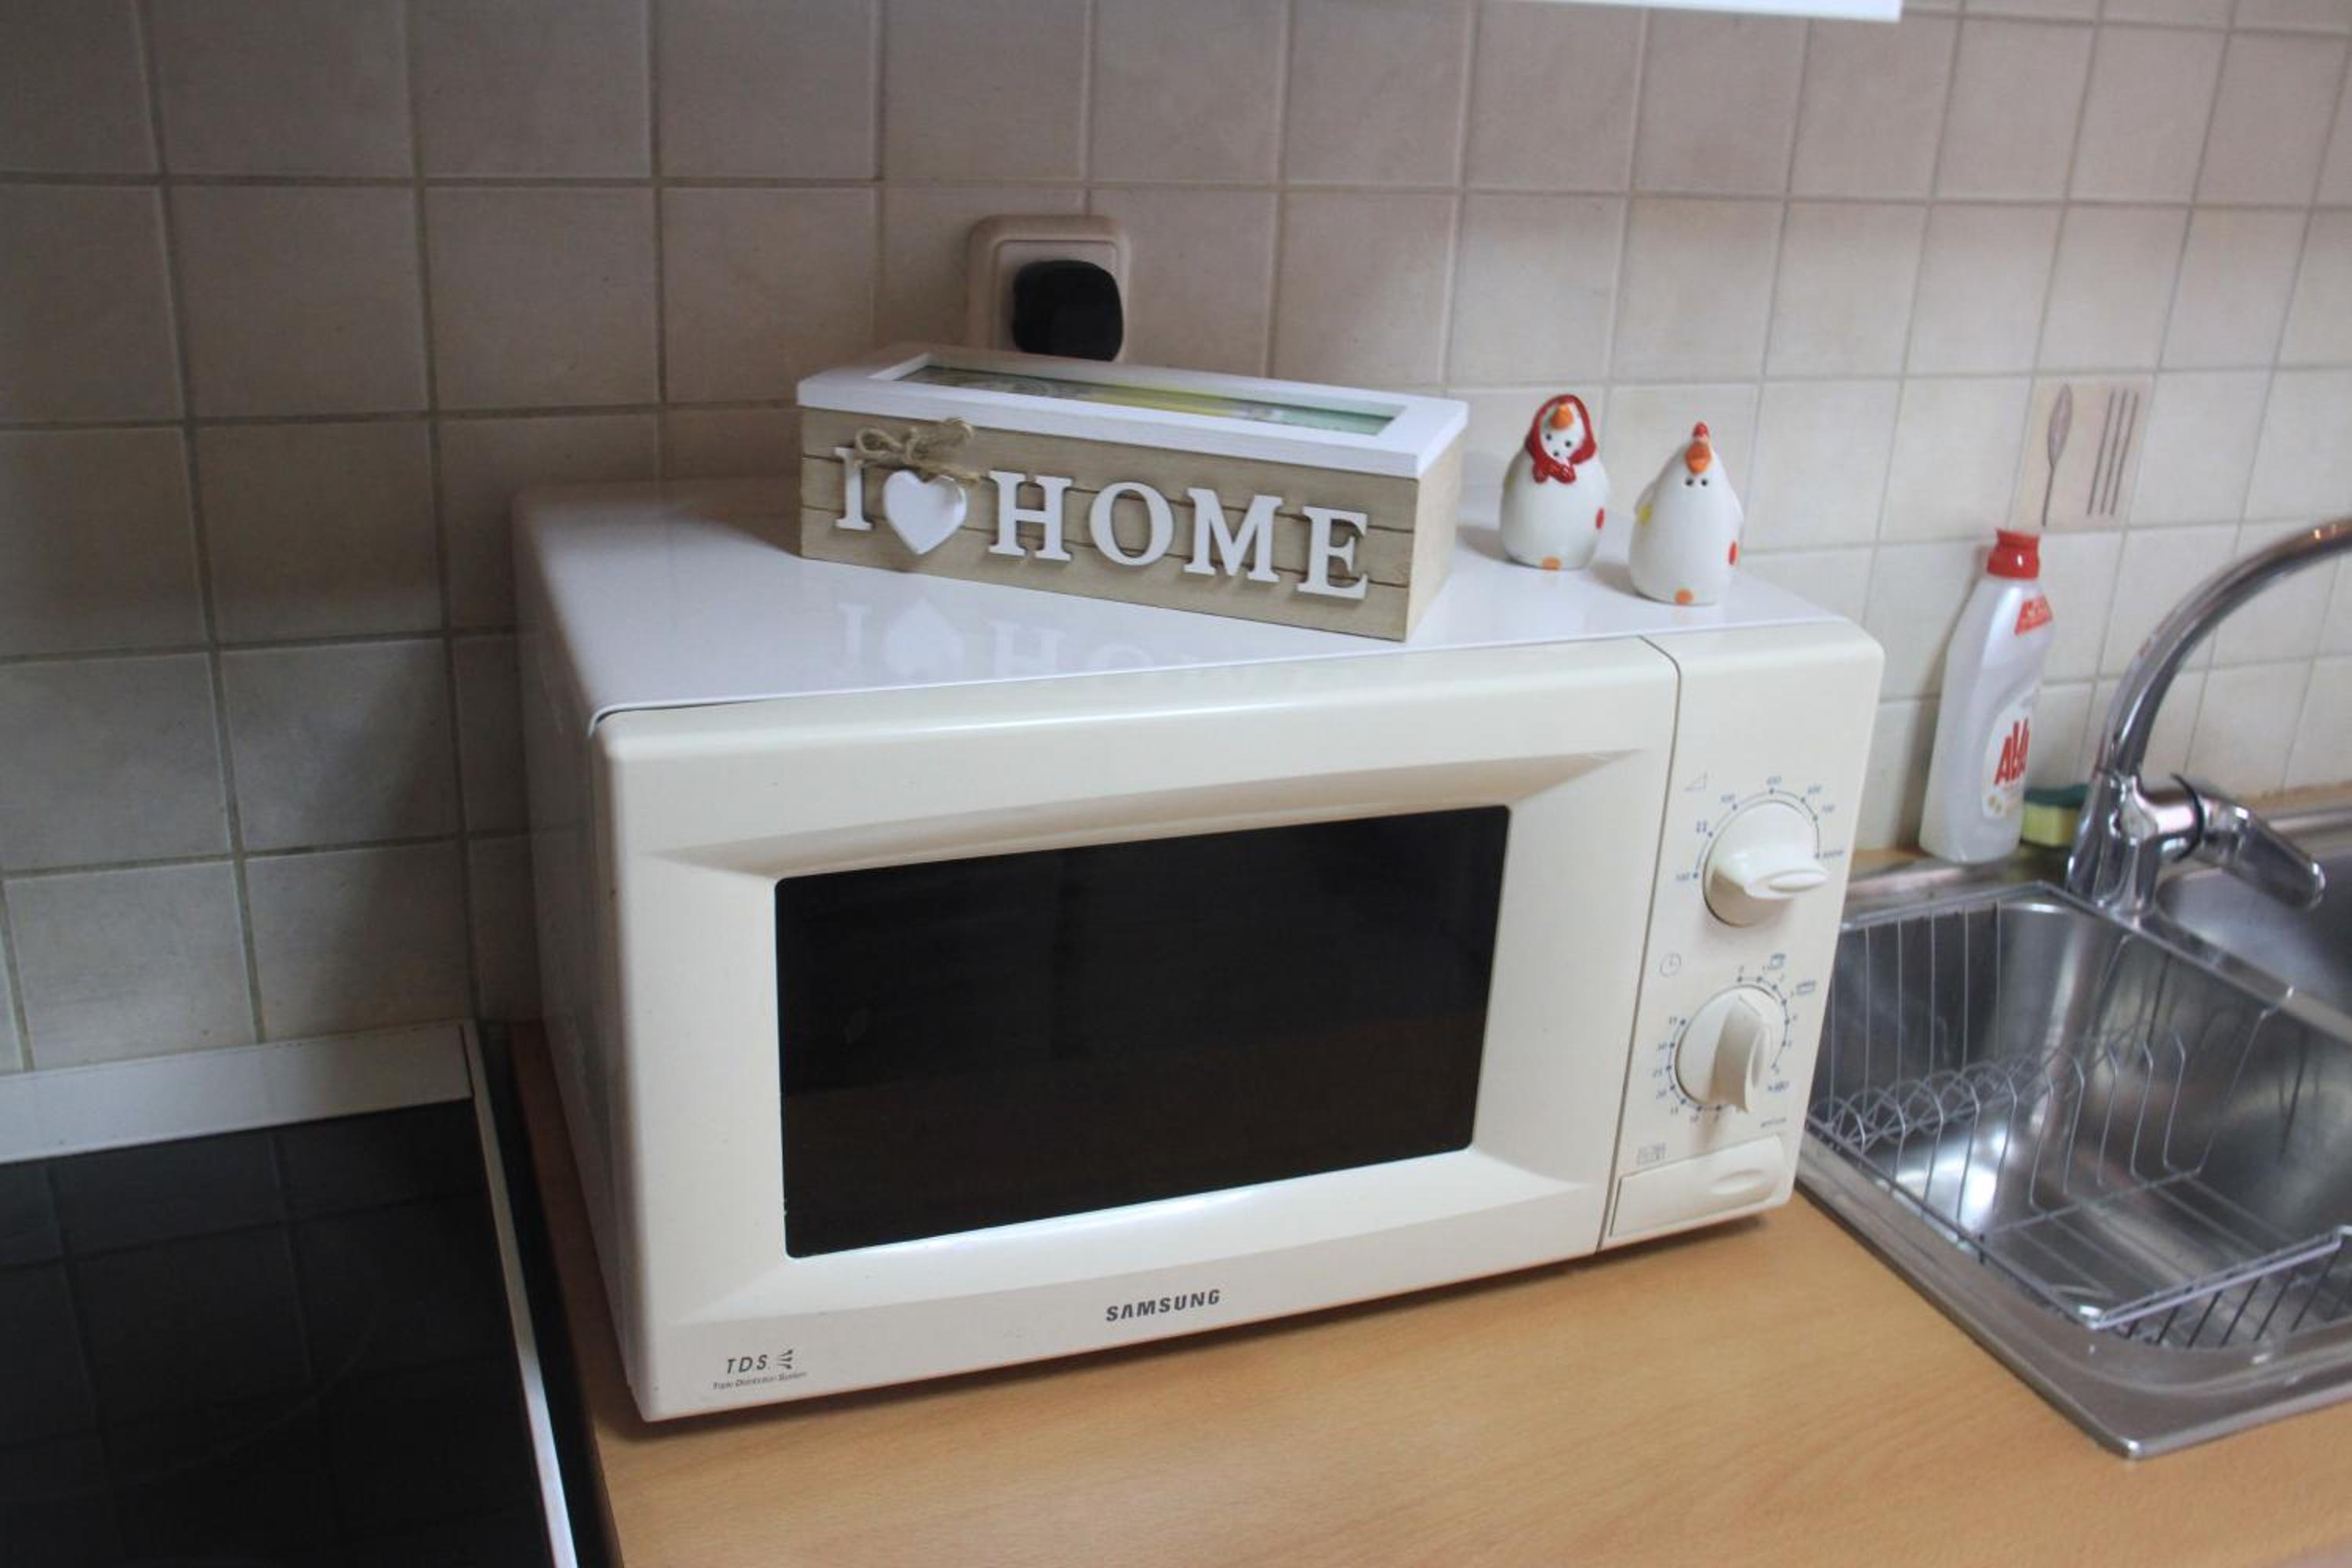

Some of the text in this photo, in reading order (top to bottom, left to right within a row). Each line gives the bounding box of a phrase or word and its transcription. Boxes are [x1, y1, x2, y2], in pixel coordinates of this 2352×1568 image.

[834, 446, 1368, 601] I HOME
[1105, 1289, 1221, 1322] SAMSUNG
[726, 1354, 768, 1374] TDS
